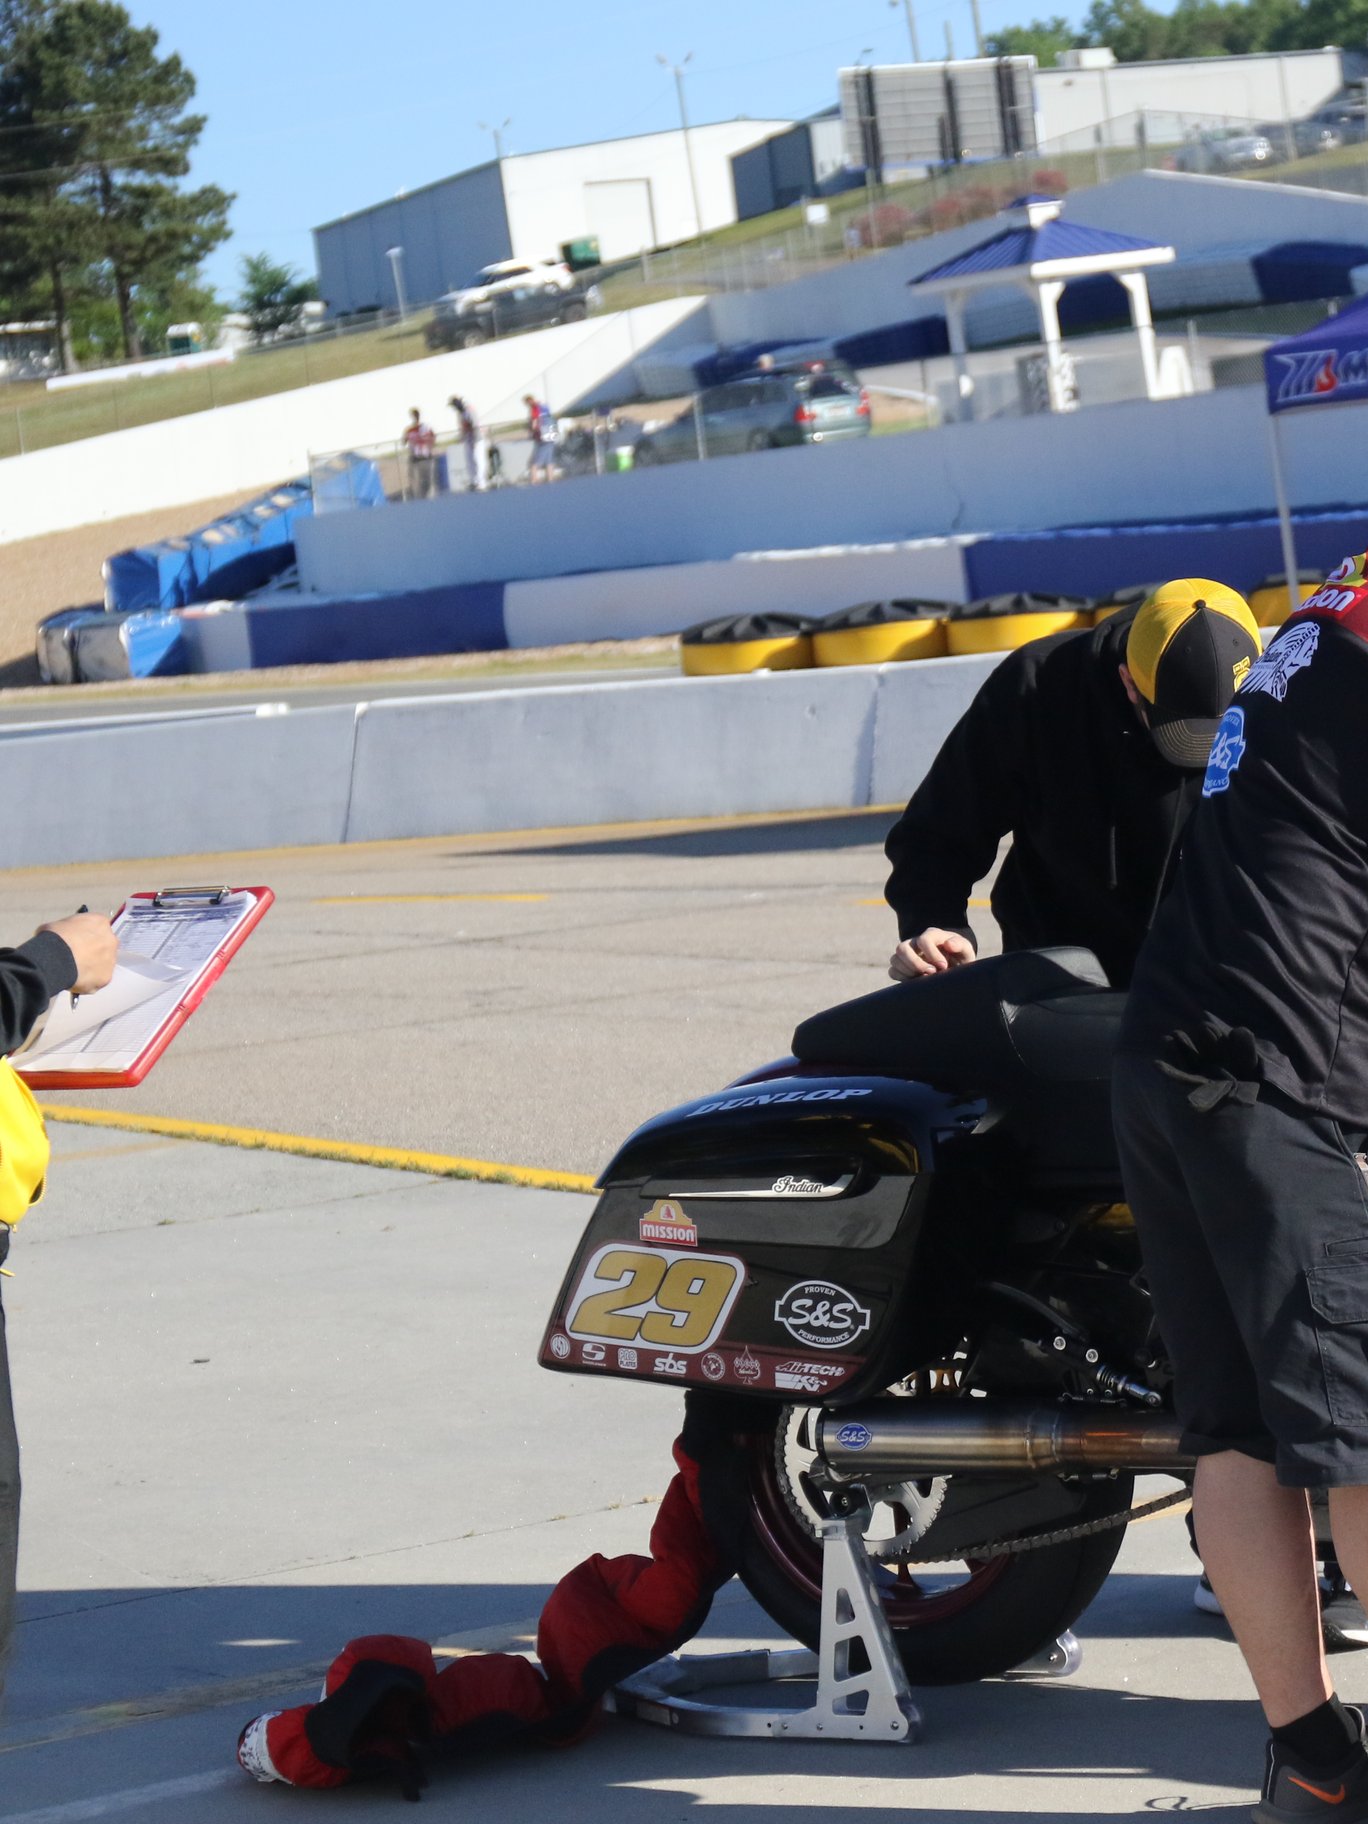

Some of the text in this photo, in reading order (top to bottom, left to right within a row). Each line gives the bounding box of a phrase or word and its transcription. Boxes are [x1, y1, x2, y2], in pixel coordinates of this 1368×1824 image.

[684, 1089, 872, 1118] DUNLOP
[771, 1175, 824, 1195] Indian
[642, 1223, 695, 1243] MISSION
[568, 1250, 738, 1348] 29
[803, 1285, 836, 1297] PROVEN
[787, 1299, 852, 1330] S&S
[797, 1328, 850, 1345] PERFORMANCE
[619, 1349, 637, 1361] PRO
[653, 1353, 687, 1375] sbs
[840, 1428, 867, 1443] S&S
